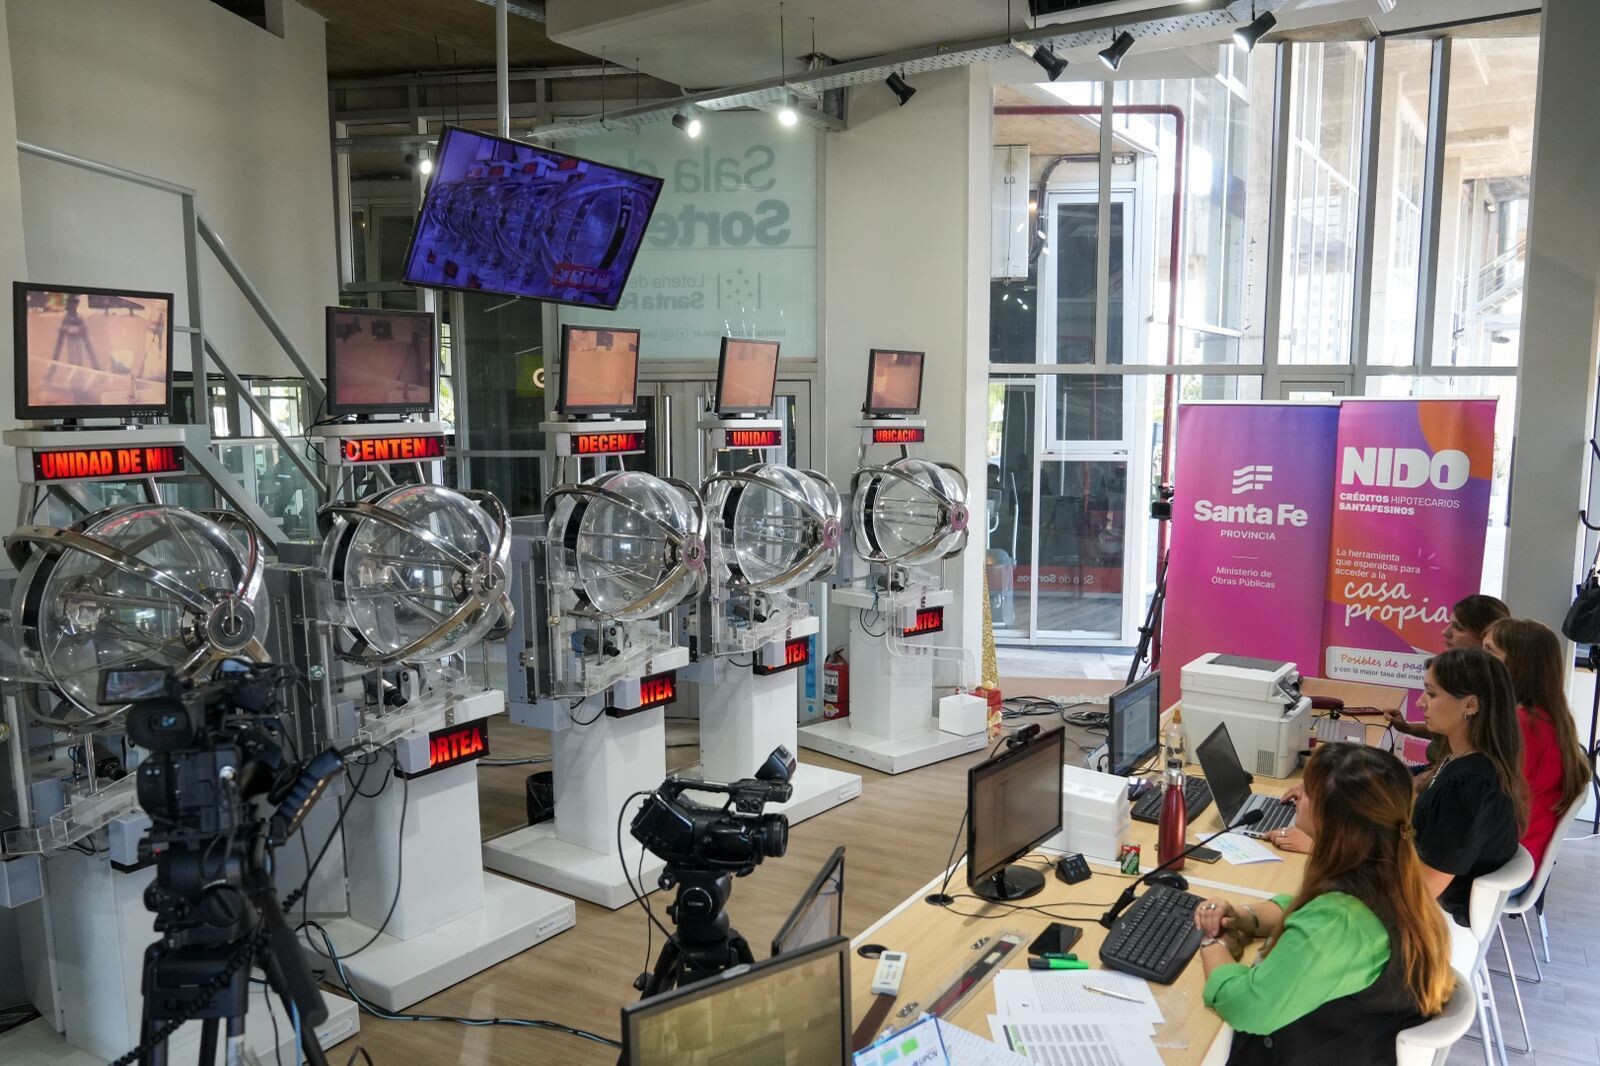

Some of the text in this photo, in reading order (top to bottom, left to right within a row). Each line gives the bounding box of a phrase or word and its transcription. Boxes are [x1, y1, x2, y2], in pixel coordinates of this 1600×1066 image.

[1003, 176, 1016, 185] LG
[578, 433, 637, 453] DECENA
[733, 431, 775, 446] UNIDAD
[345, 437, 440, 462] CENTENA
[40, 447, 177, 479] UNIDAD DE MIL
[1341, 446, 1471, 490] NIDO
[1339, 491, 1461, 509] CRÉDITOS HIPOTECARIOS
[1193, 499, 1308, 527] Santa Fe
[1338, 502, 1415, 516] SANTAFESINOS
[1220, 529, 1276, 541] PROVINCIA
[1336, 547, 1400, 562] La herramienta
[1216, 566, 1272, 578] Ministerio de
[1335, 558, 1421, 575] que esperabas para
[1335, 567, 1369, 578] acceder
[1378, 571, 1386, 580] la
[1211, 575, 1276, 589] Obras Públicas
[1344, 581, 1412, 602] casa
[1344, 597, 1450, 630] propia
[1340, 653, 1381, 667] Posibles
[1385, 658, 1399, 669] de
[1360, 668, 1379, 677] mejor
[1380, 670, 1395, 678] tasa
[1395, 671, 1407, 679] del
